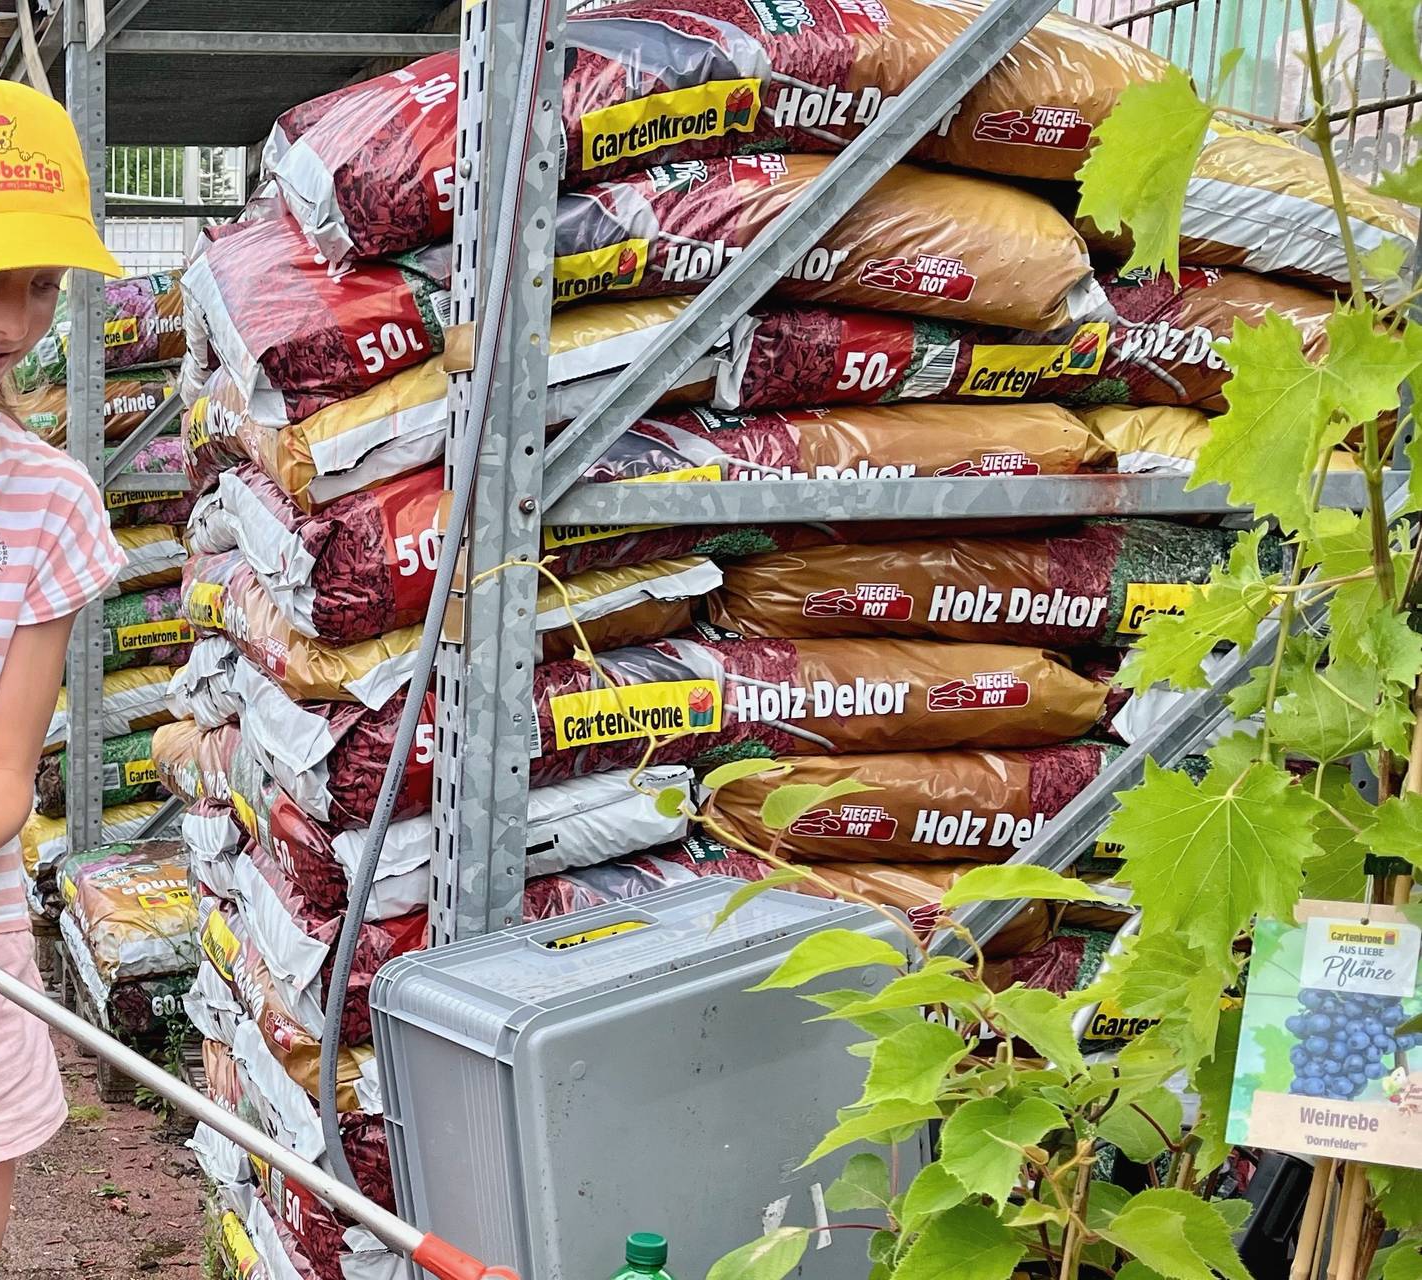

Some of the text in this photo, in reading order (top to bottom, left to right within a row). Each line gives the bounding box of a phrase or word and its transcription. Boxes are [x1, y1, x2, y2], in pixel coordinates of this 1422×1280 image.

[774, 84, 852, 128] Holz
[1031, 106, 1081, 129] ZIEGEL-
[592, 106, 717, 161] Gartenkrone
[1035, 127, 1066, 145] ROT
[916, 256, 966, 277] ZIEGEL-
[919, 277, 949, 294] ROT
[356, 322, 423, 374] 50L
[113, 392, 156, 415] Rinde
[857, 585, 903, 602] ZIEGEL-
[862, 602, 887, 617] ROT
[928, 584, 1002, 623] Holz
[1006, 587, 1108, 628] Dekor
[122, 630, 178, 649] Gartenkrone
[974, 673, 1018, 689] ZIEGEL-
[737, 677, 910, 723] Holz Dekor
[983, 688, 1007, 705] ROT
[564, 702, 684, 743] Gartenkrone
[841, 806, 887, 823] ZIEGEL-
[846, 821, 871, 837] ROT
[912, 809, 989, 846] Holz
[1330, 930, 1382, 945] Gartenkrone
[1338, 945, 1385, 957] AUS LIEBE
[1322, 954, 1396, 986] Pflanze
[1299, 1106, 1379, 1133] Weinrebe
